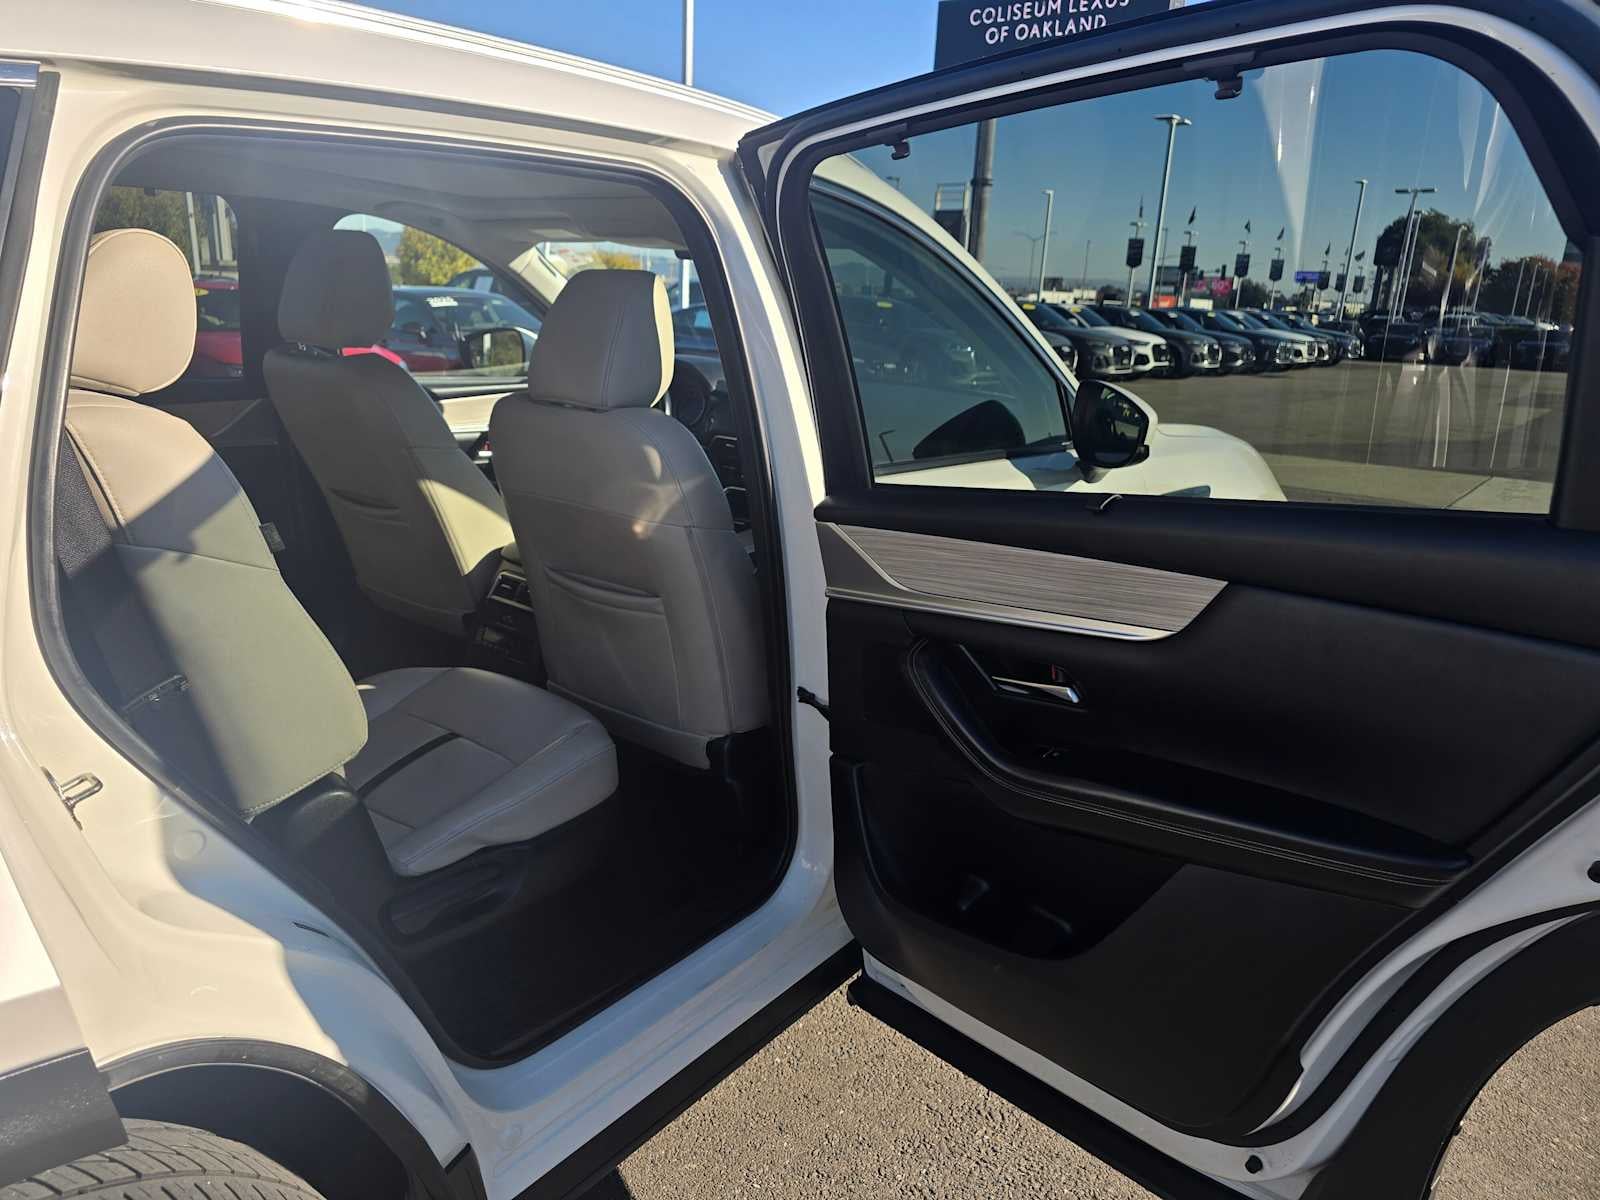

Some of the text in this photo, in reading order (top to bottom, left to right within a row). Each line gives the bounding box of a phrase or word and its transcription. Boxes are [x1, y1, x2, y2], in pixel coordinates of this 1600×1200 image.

[970, 0, 1060, 26] COLISEUM
[985, 14, 1107, 45] OF OAKLAND
